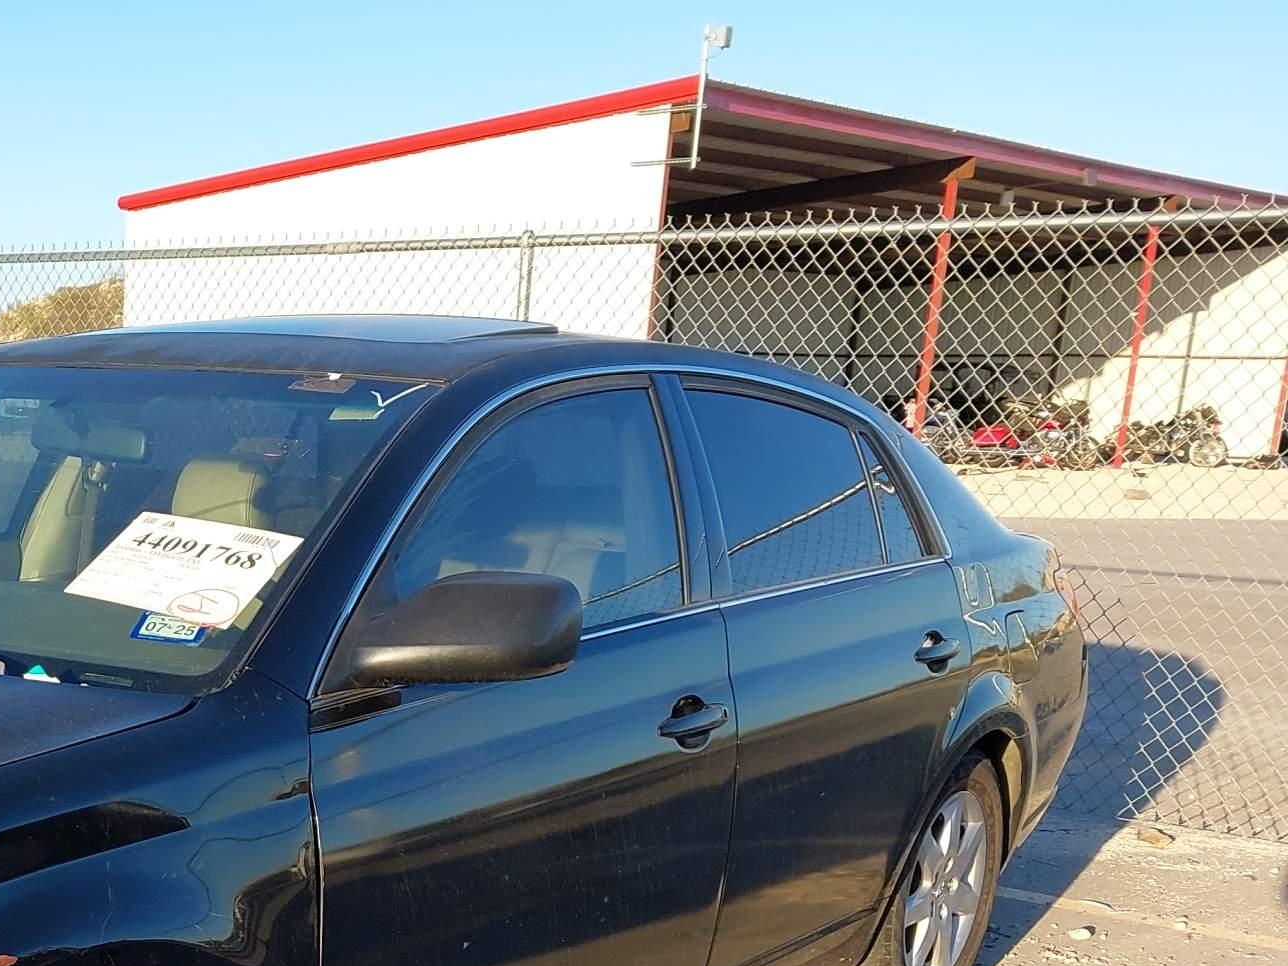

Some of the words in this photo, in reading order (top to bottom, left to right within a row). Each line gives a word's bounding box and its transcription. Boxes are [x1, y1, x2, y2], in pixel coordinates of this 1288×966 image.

[131, 531, 263, 570] 44091768
[144, 621, 168, 633] 07
[172, 624, 197, 636] 25
